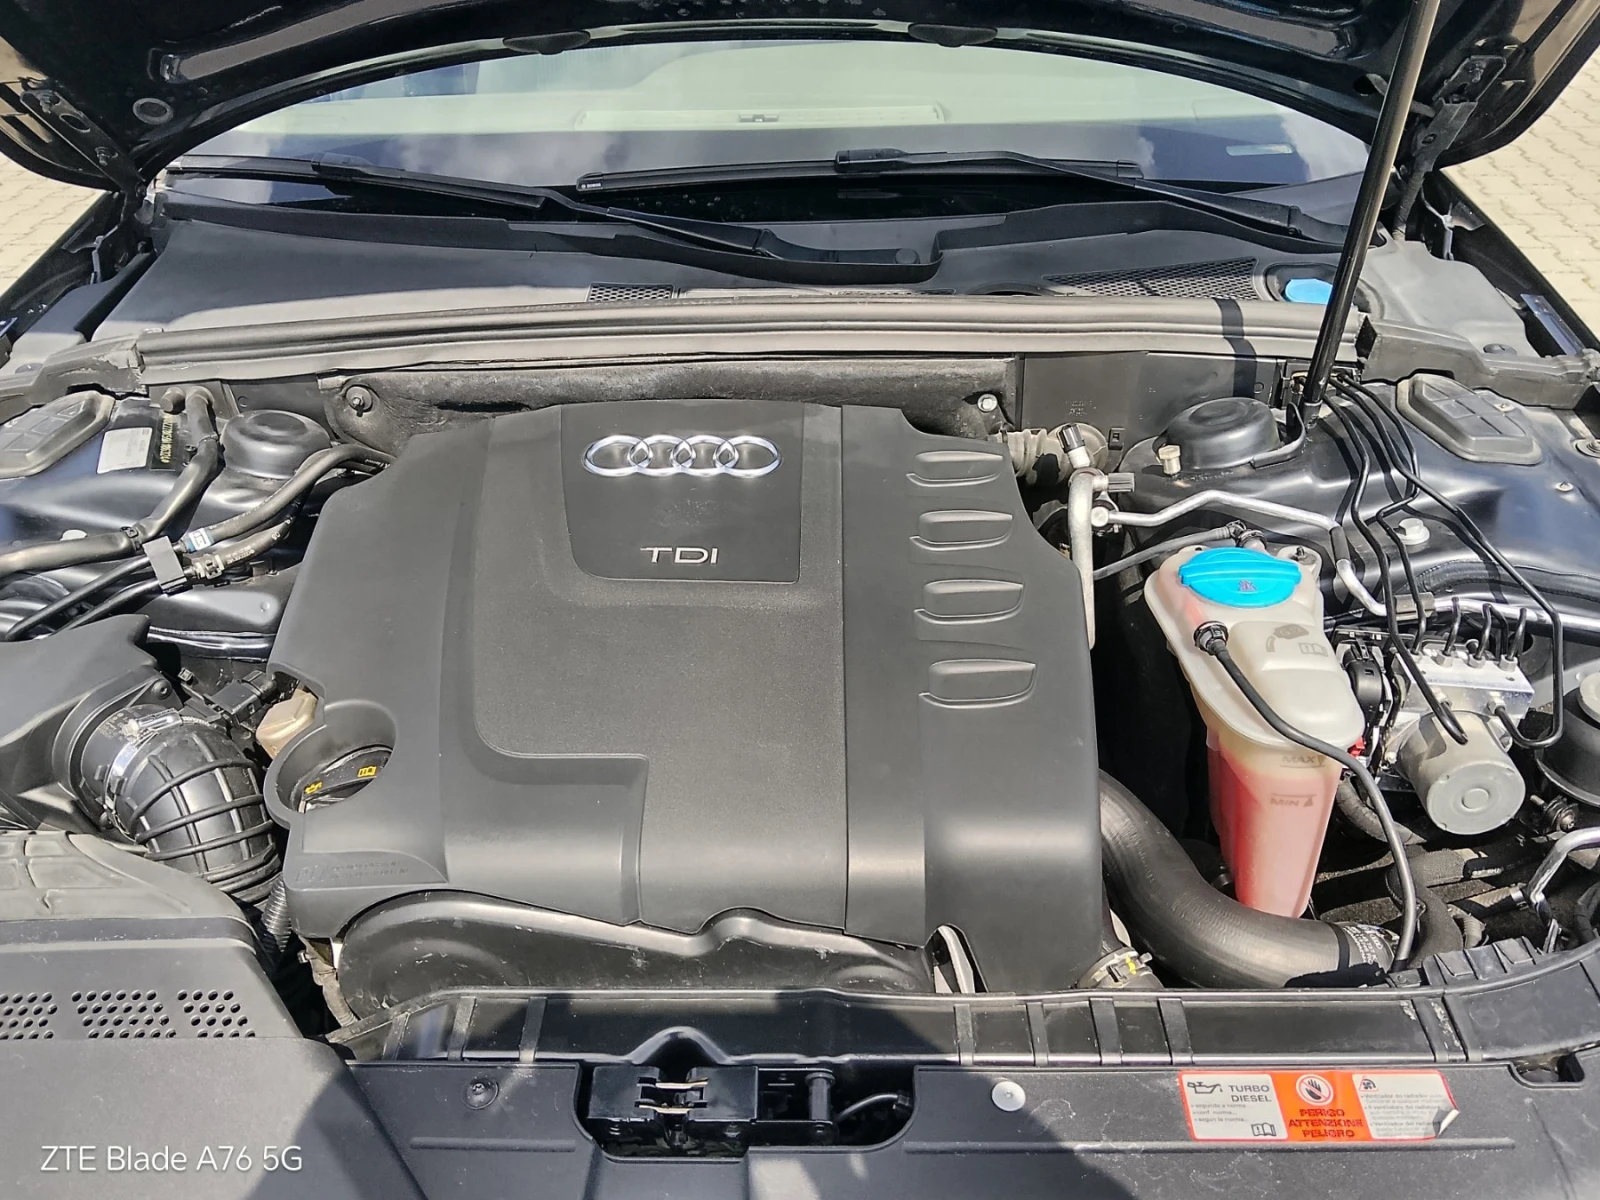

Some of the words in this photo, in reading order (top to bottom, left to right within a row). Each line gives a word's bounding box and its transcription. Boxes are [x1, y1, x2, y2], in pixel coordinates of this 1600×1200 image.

[640, 547, 718, 564] TDI
[1283, 755, 1316, 763] MAX
[1270, 798, 1299, 806] MIN
[1231, 1094, 1272, 1102] DIESEL
[1299, 1108, 1345, 1117] PERIGO
[1289, 1118, 1364, 1127] ATTENZIONE
[1302, 1129, 1355, 1138] PELIGRO
